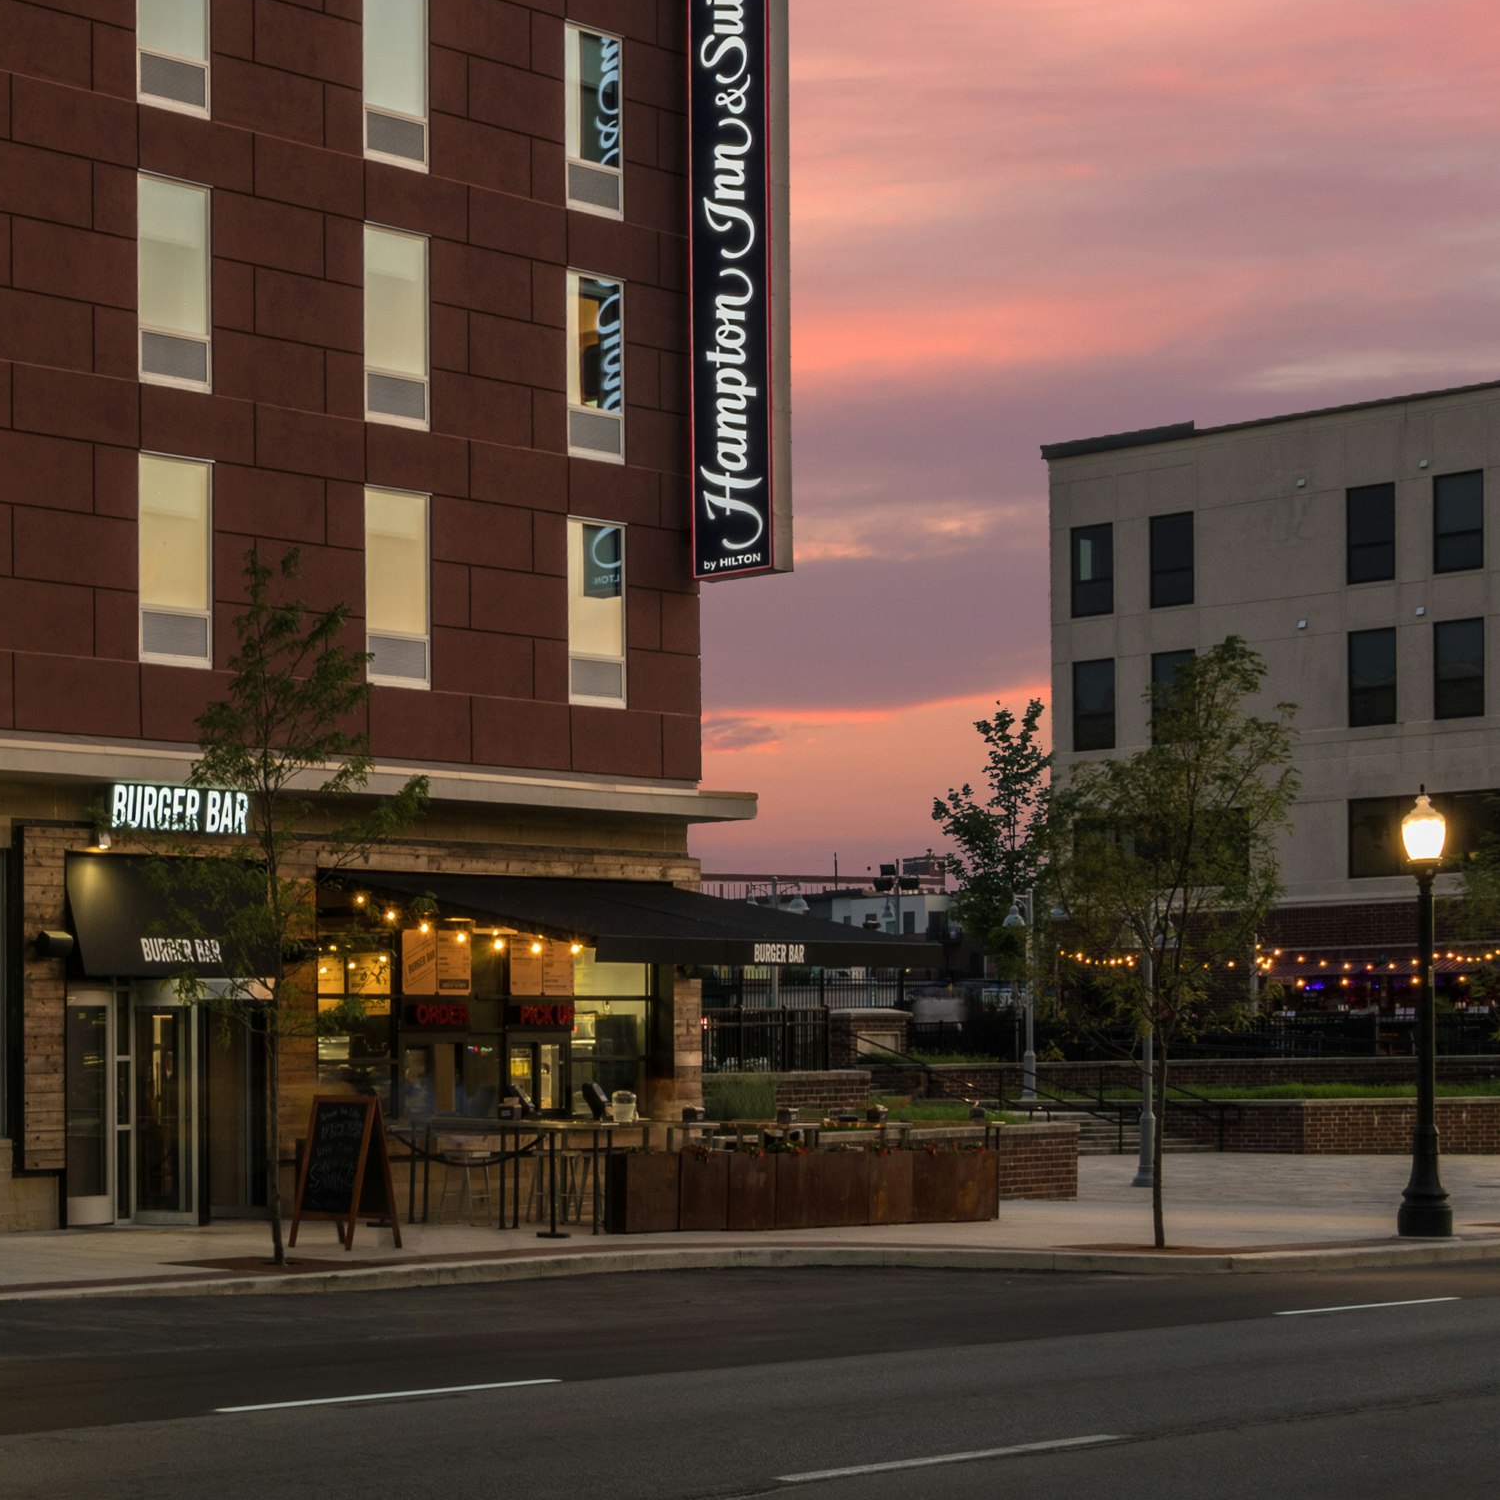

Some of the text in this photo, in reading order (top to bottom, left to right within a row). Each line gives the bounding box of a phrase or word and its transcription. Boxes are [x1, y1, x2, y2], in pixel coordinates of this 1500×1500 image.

[715, 74, 751, 116] &
[703, 117, 755, 261] Inn
[700, 268, 763, 550] Hampton
[703, 552, 761, 571] by HILTON
[111, 784, 249, 835] BURGER BAR
[140, 937, 223, 963] BURGER BAR
[754, 943, 805, 964] BURGER BAR
[408, 956, 426, 974] BURGER
[416, 1003, 469, 1025] ORDER
[520, 1003, 553, 1025] PICK
